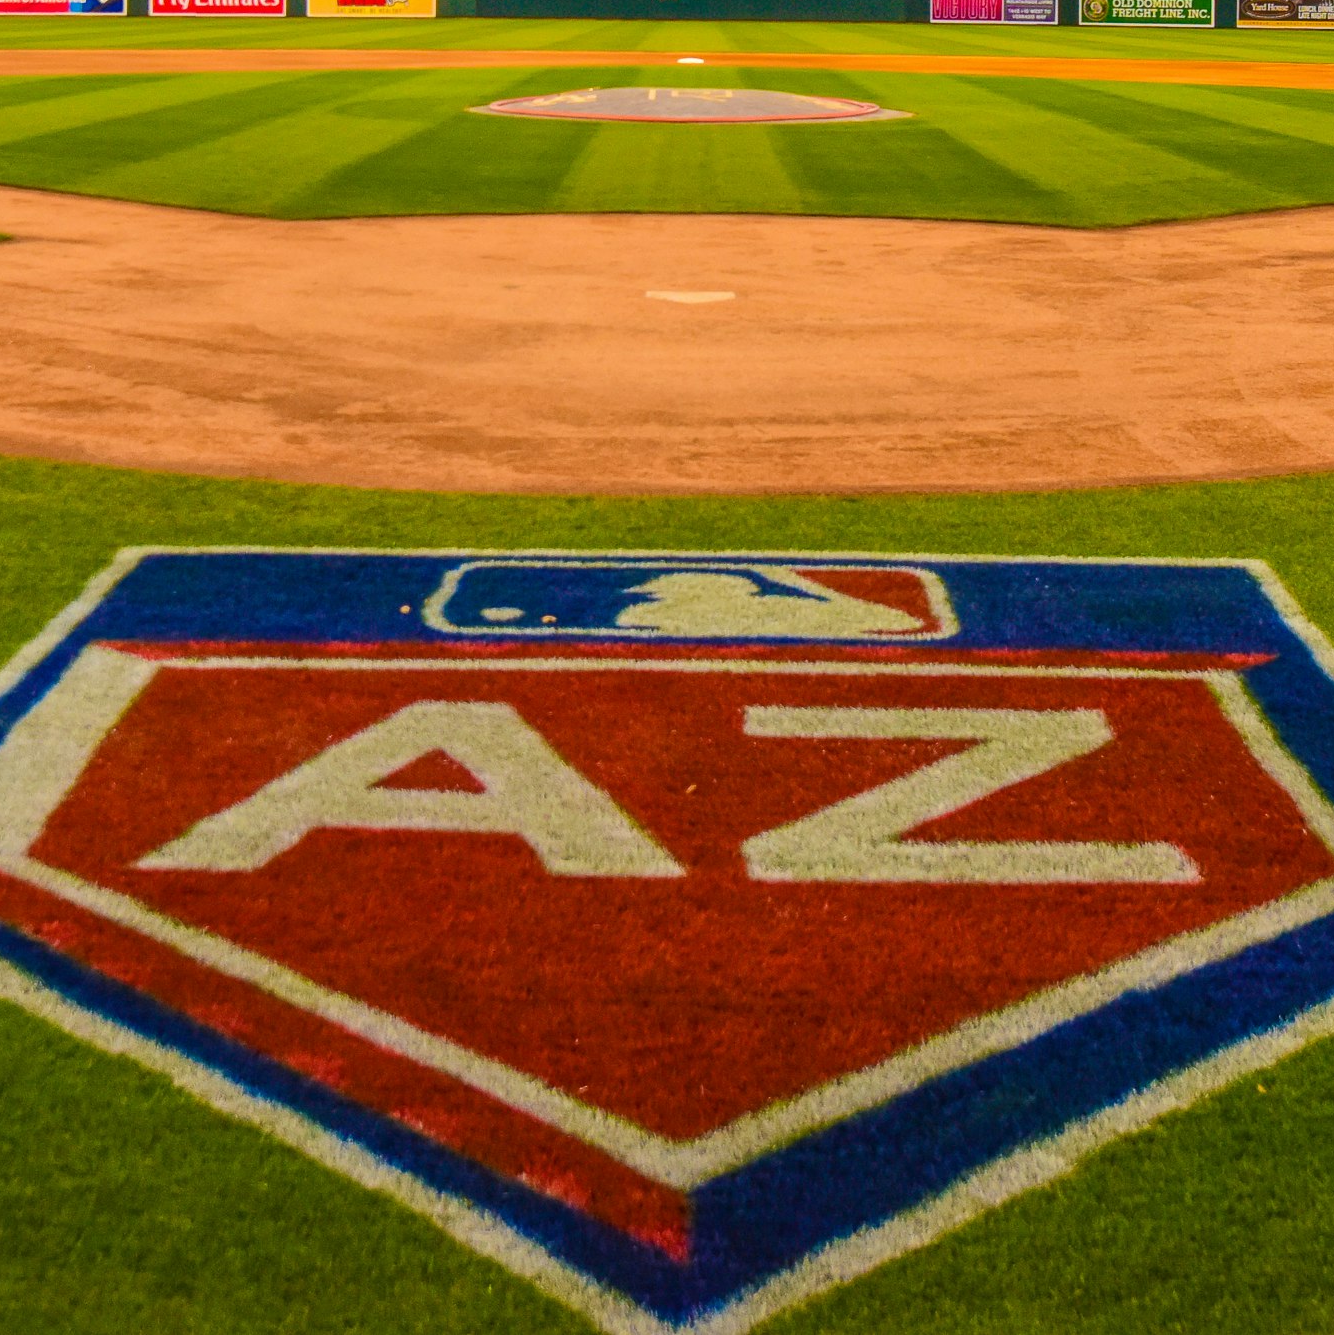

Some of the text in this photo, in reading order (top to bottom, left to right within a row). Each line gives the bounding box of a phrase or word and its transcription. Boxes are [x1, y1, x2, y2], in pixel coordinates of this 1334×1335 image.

[1250, 2, 1290, 12] Yard House
[1112, 8, 1158, 18] FREIGHT
[1187, 9, 1211, 19] INC.
[131, 699, 1204, 885] AZ
